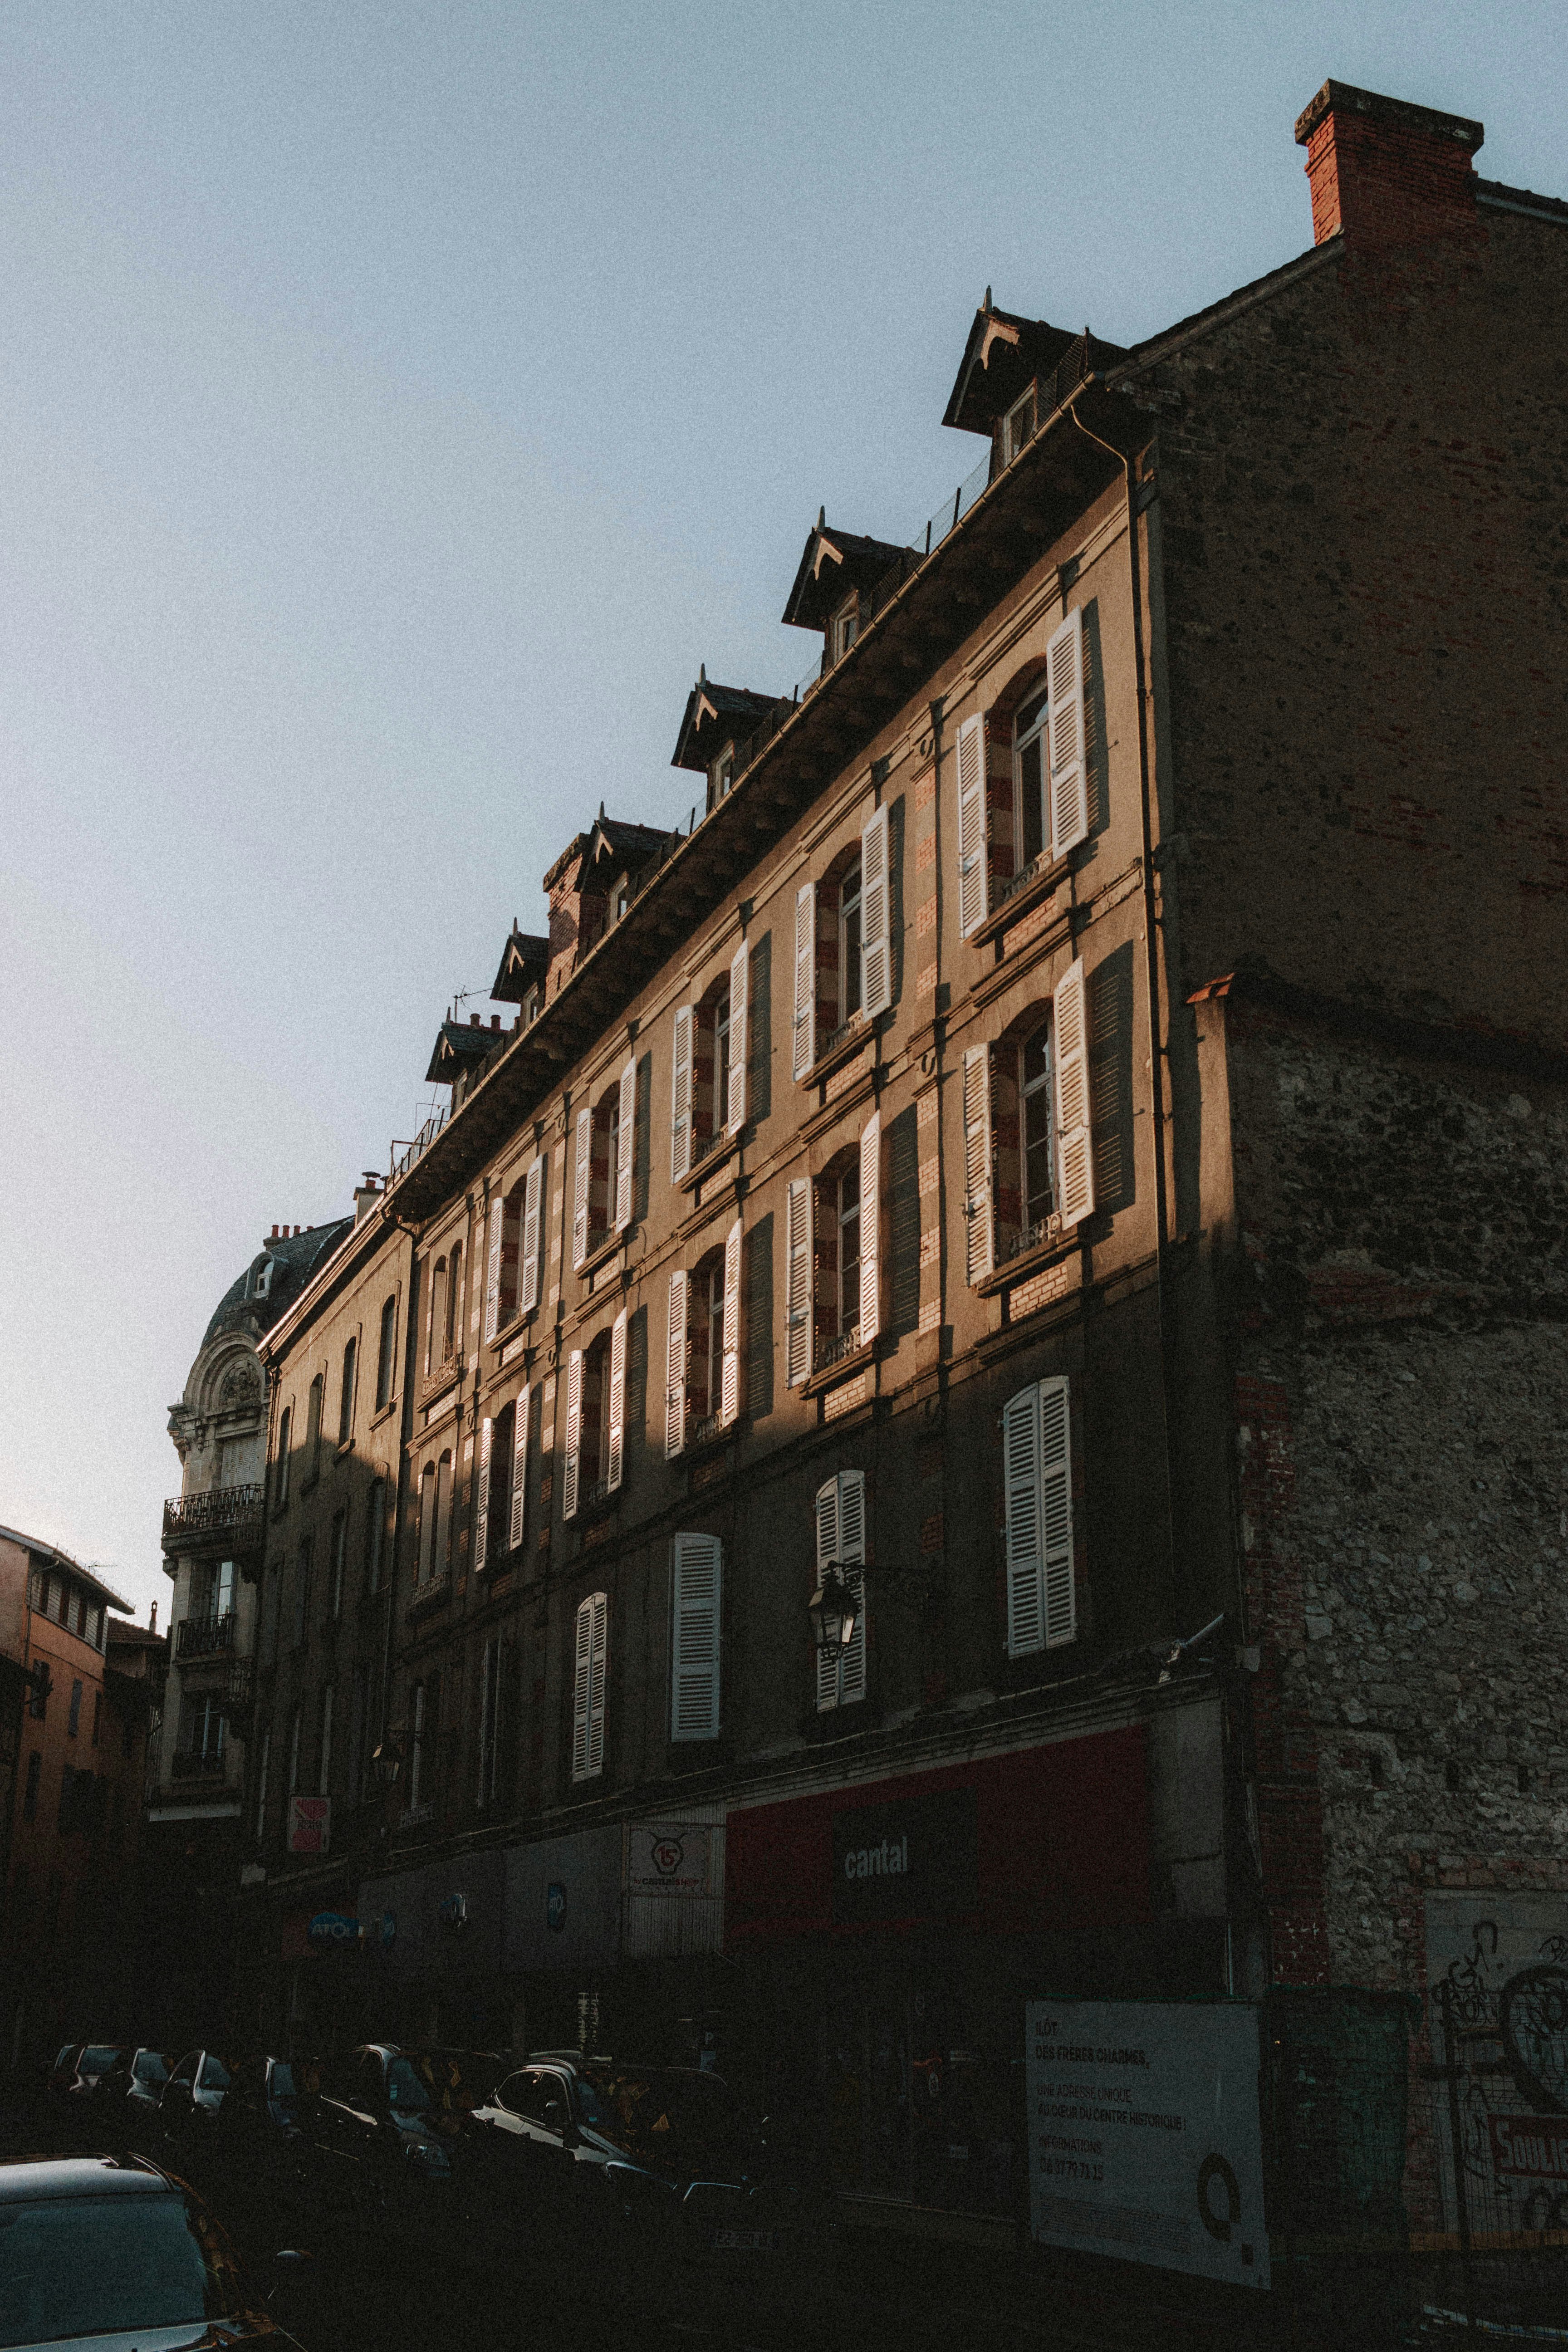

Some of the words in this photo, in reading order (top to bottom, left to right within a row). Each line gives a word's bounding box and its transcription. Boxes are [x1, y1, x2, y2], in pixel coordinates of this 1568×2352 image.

[844, 1836, 908, 1879] cantal
[1036, 2045, 1055, 2060] DES
[1038, 2083, 1055, 2096] UNE
[1057, 2084, 1095, 2099] ADRESSE
[1038, 2103, 1049, 2116] AU
[1079, 2107, 1091, 2120] DU
[1094, 2108, 1127, 2124] CENTRE
[1130, 2112, 1181, 2130] HISTORIQUE
[1039, 2135, 1102, 2154] INFORMATIONS
